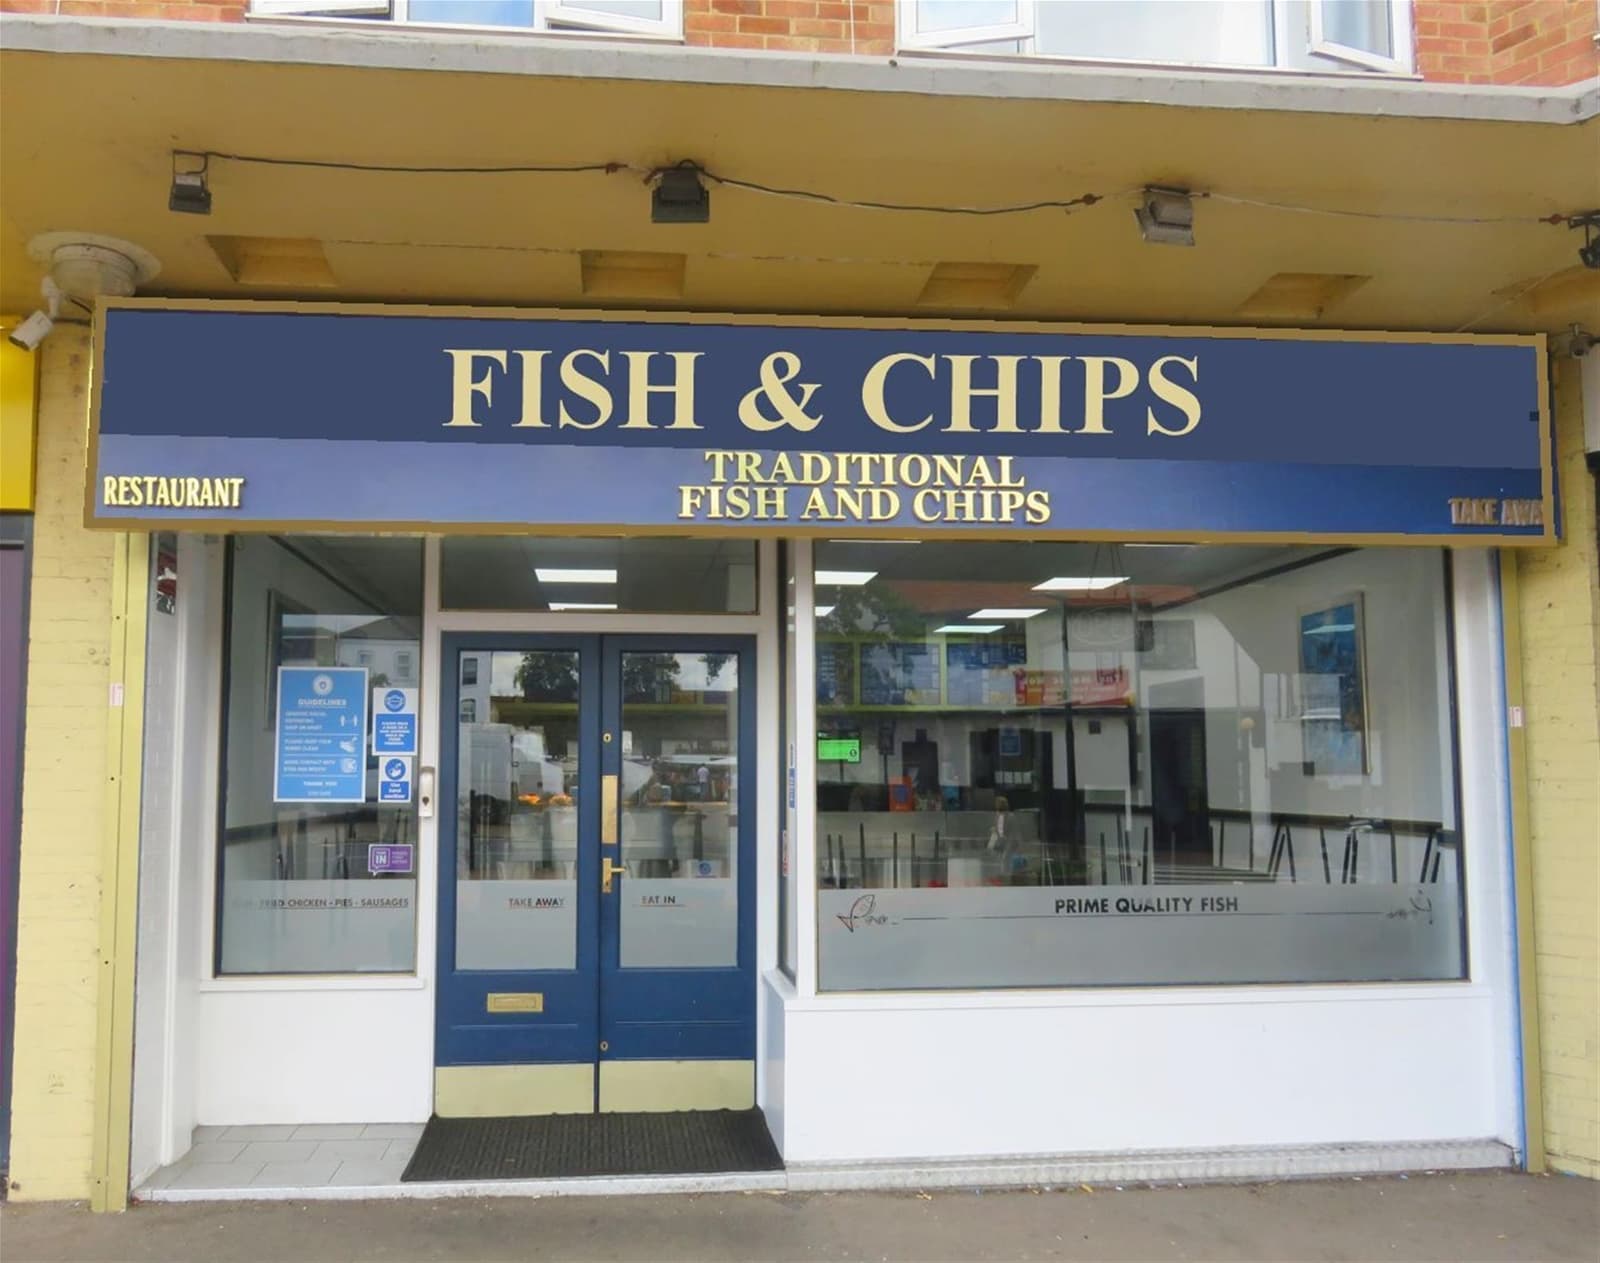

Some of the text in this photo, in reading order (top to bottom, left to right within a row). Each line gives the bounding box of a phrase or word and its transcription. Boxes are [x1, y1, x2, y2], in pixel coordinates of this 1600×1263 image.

[442, 349, 1202, 436] FISH & CHIPS
[704, 451, 1026, 489] TRADITIONAL
[103, 476, 245, 507] RESTAURANT
[678, 486, 1051, 524] FISH AND CHIPS
[1448, 498, 1544, 526] TAKE AWA
[287, 898, 327, 908] CHICKEN
[335, 898, 353, 907] PIES
[361, 897, 409, 907] SAUSAGES
[508, 898, 564, 908] TAKE AWAY
[642, 896, 676, 905] EAT IN
[1055, 897, 1239, 914] PRIME QUALITY FISH
